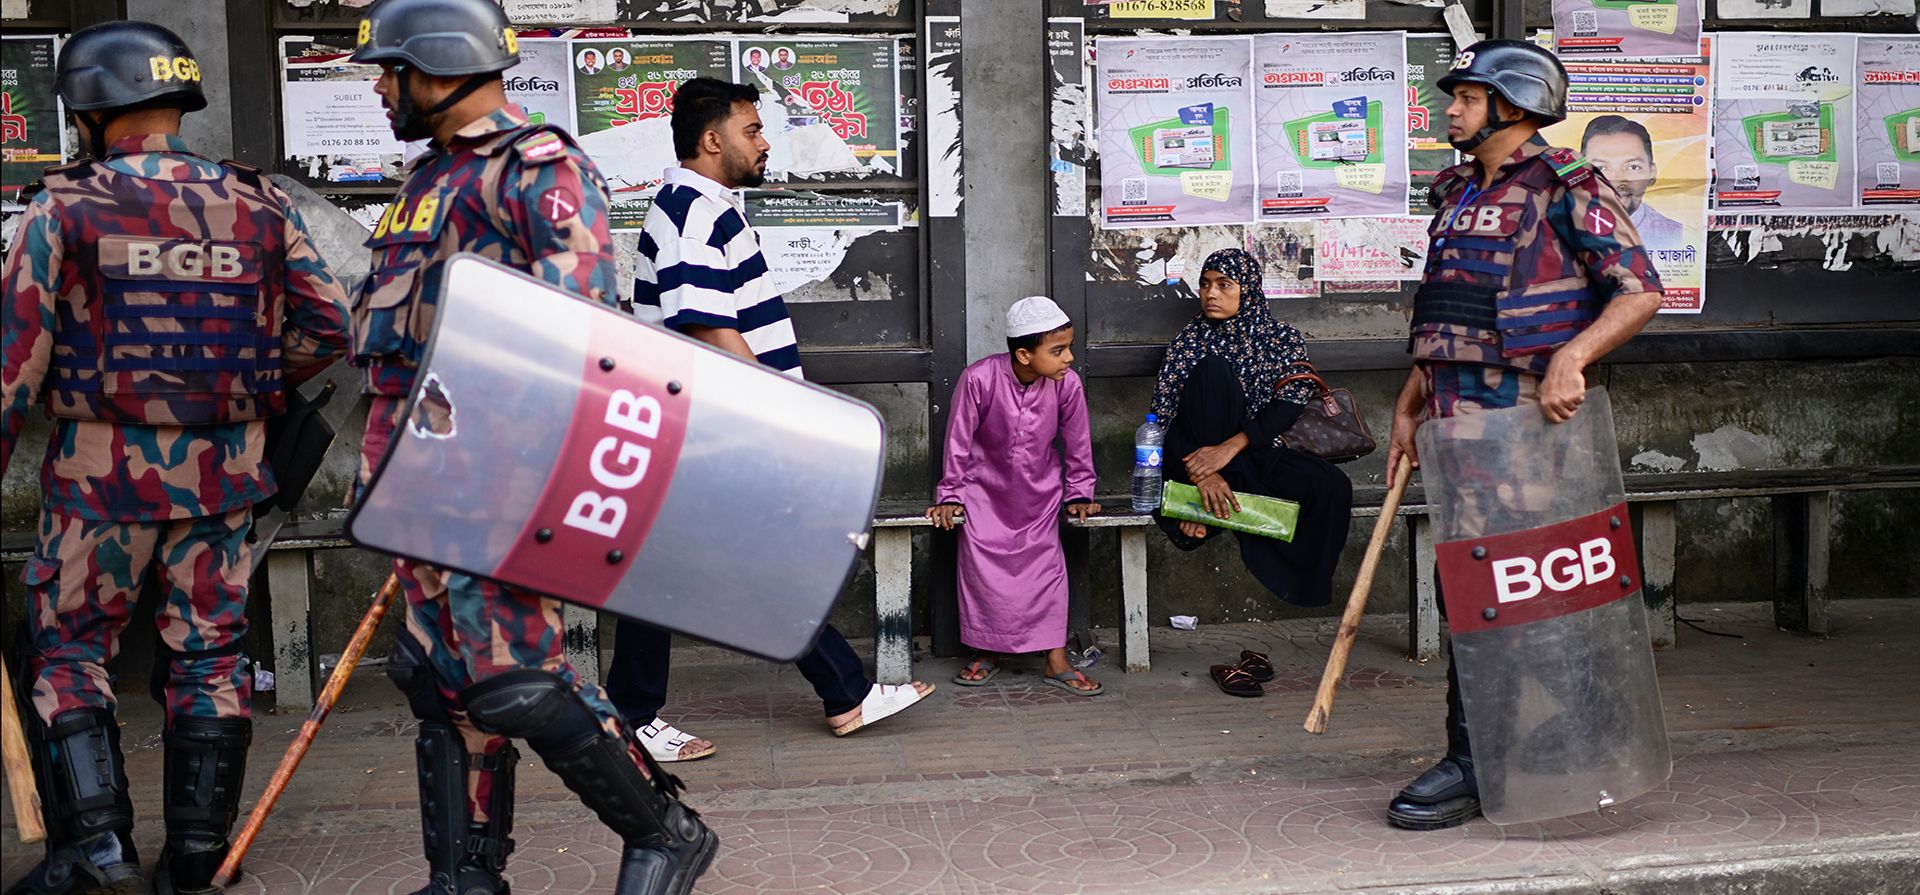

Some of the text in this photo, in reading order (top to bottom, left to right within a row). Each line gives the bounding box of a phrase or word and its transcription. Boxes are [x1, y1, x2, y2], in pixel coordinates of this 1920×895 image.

[1116, 0, 1206, 11] 01676-828568
[149, 55, 201, 82] BGB
[1449, 51, 1476, 70] GB
[827, 68, 861, 80] অক্টোবর
[1186, 73, 1242, 89] প্রতিদিন
[1264, 72, 1324, 85] অগ্রযাত্রা
[1340, 66, 1396, 83] প্রতিদিন
[1108, 78, 1169, 90] অগ্রযাত্রা
[334, 94, 363, 102] SUBLET
[366, 138, 380, 146] 150
[1435, 205, 1503, 233] BGB
[128, 243, 243, 278] BGB
[1657, 245, 1696, 262] আজাদী
[562, 389, 662, 539] BGB
[1492, 537, 1616, 604] BGB
